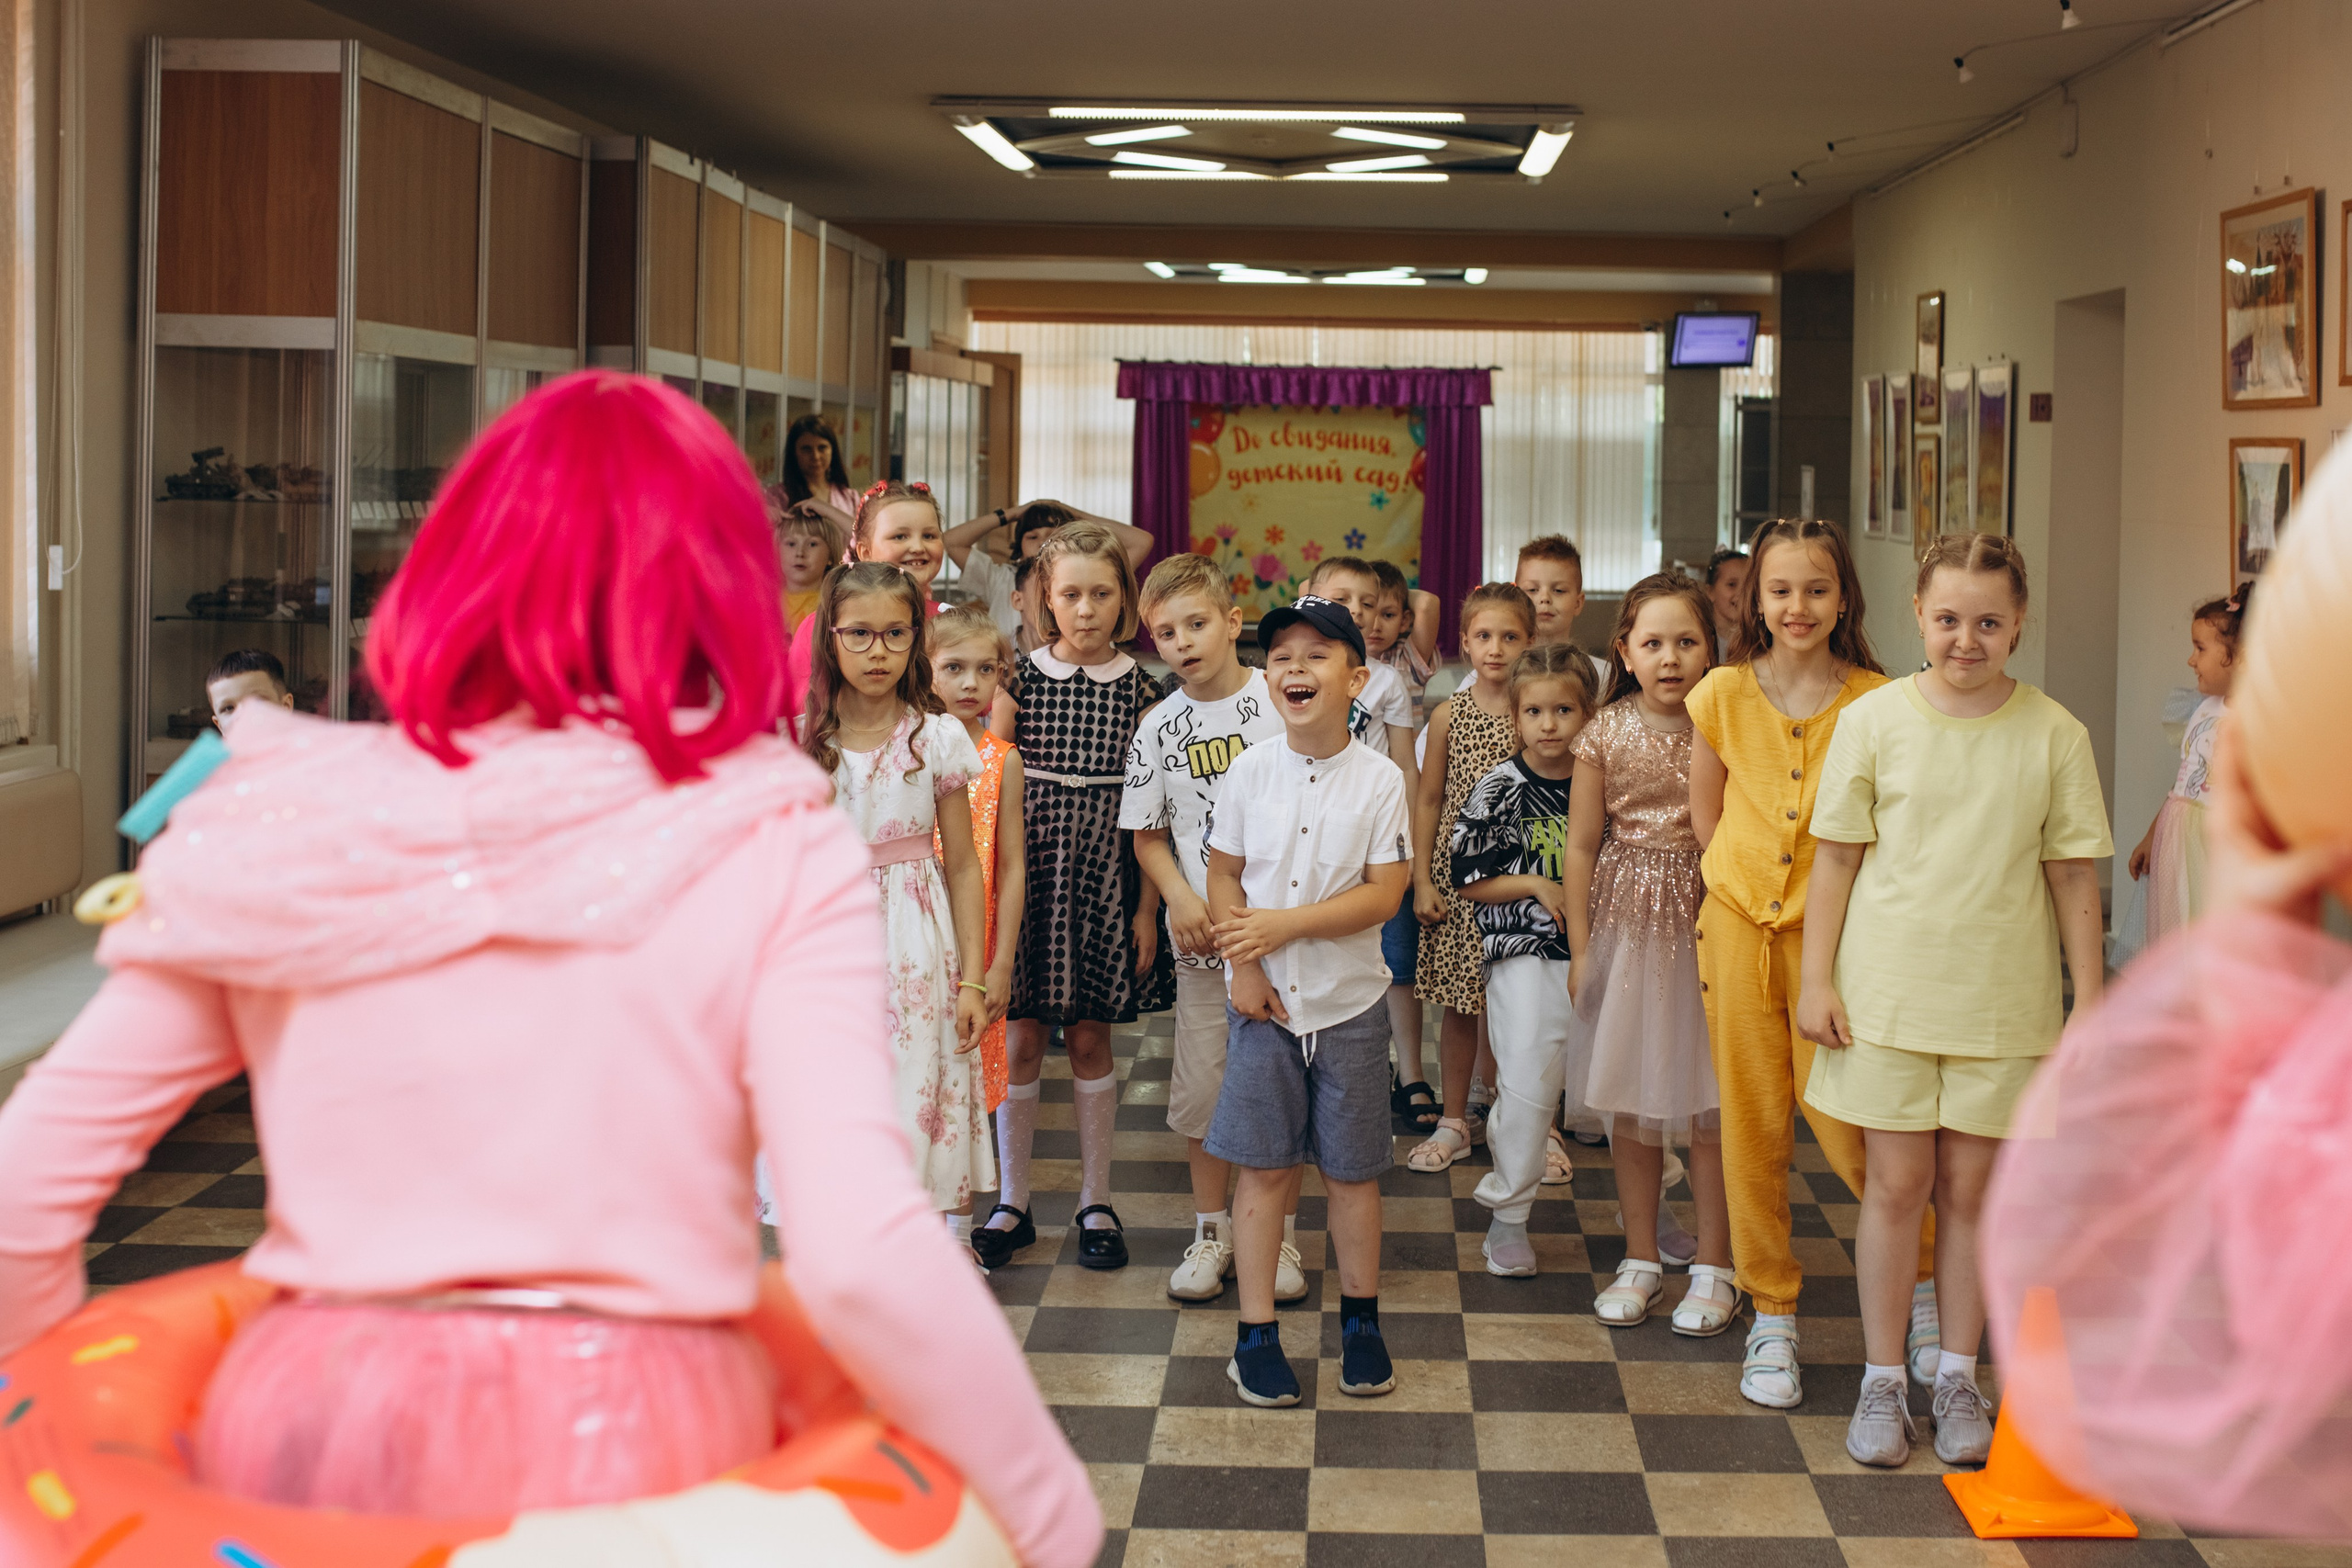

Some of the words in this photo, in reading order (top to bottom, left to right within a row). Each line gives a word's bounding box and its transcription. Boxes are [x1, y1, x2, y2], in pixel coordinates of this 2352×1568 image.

[1233, 425, 1261, 454] До
[1227, 459, 1343, 491] детский
[1354, 466, 1410, 494] сад!
